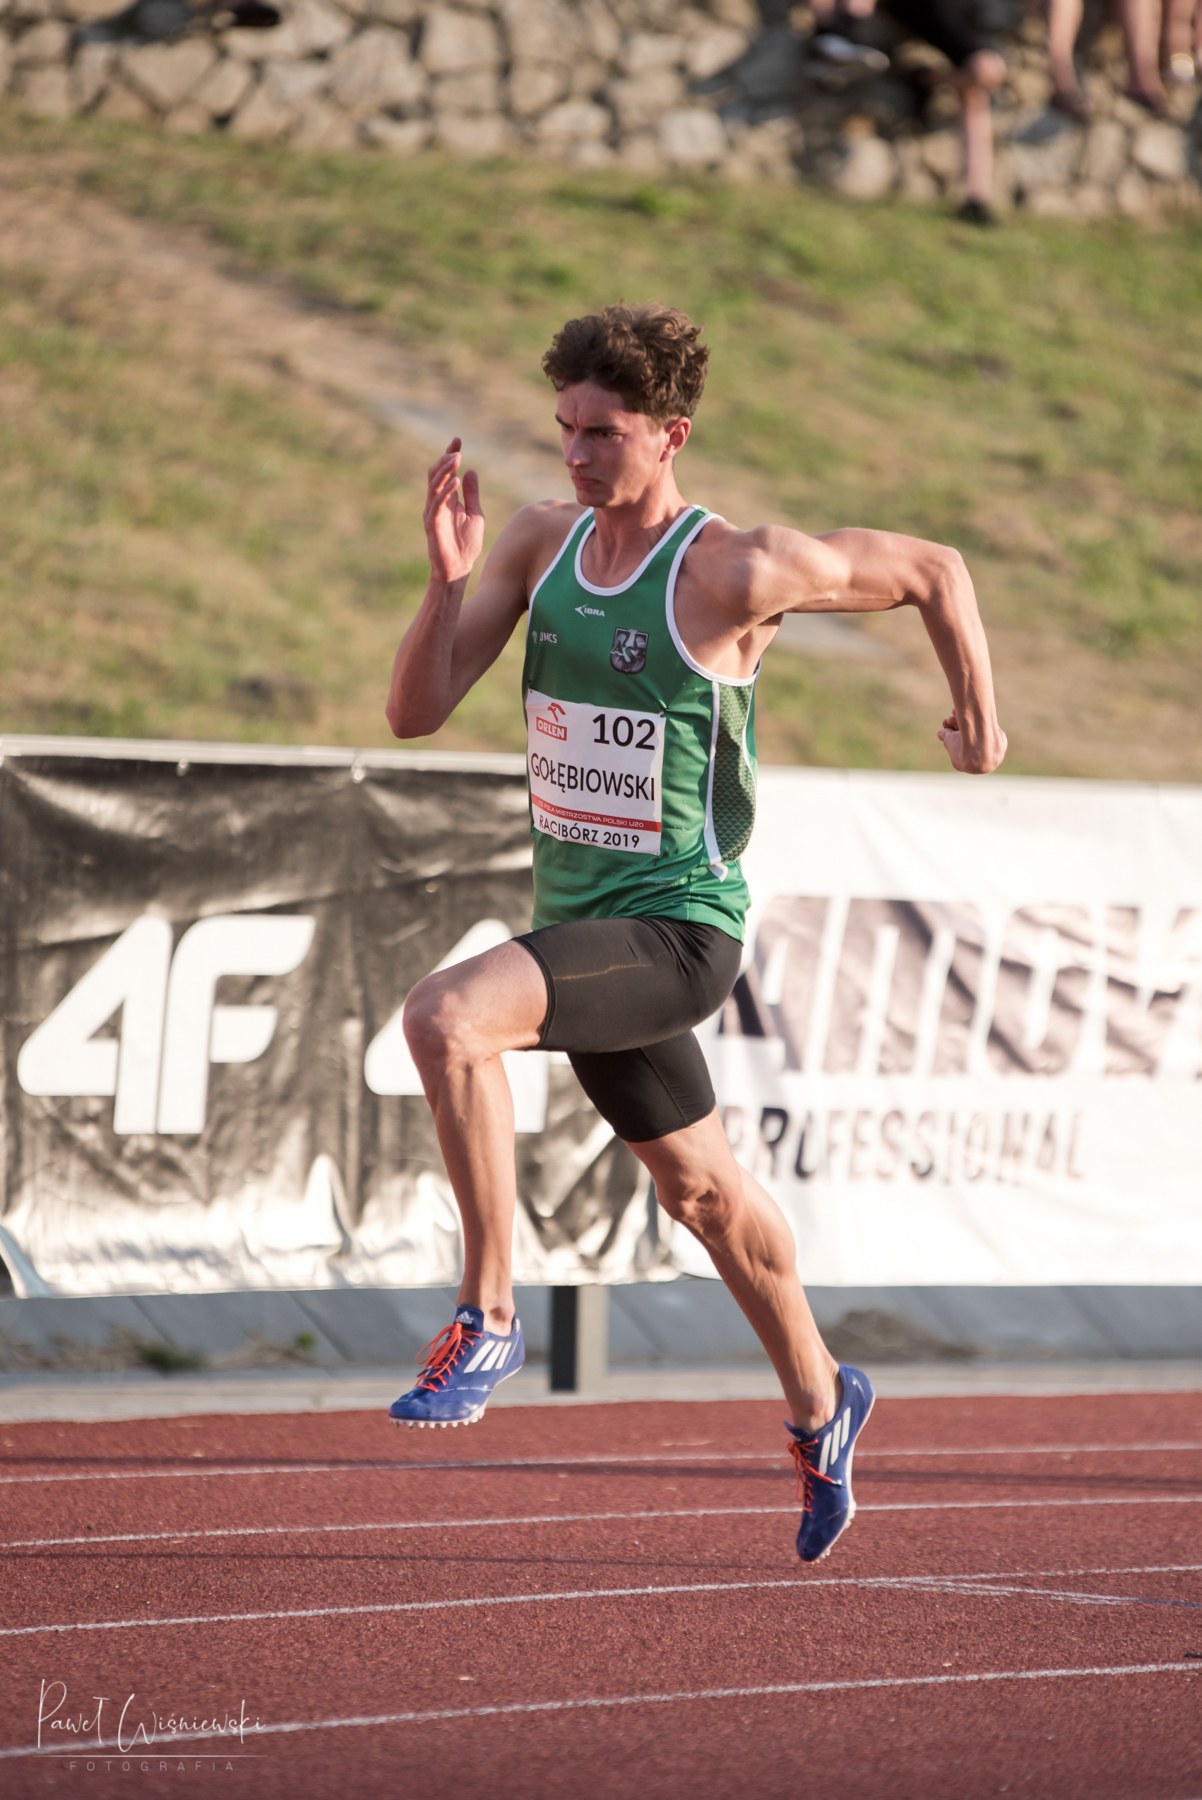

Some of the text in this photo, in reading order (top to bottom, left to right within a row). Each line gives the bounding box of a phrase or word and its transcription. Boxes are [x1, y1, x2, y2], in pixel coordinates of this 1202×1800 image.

[537, 721, 565, 739] ORLEN
[592, 713, 656, 751] 102
[530, 752, 655, 801] GOŁĘBIOWSKI
[539, 814, 640, 848] RACIBÓRZ 2019
[555, 808, 602, 823] MISTRZOSTWA
[602, 817, 628, 827] POLSKI
[628, 820, 645, 828] U20
[17, 914, 316, 1134] 4F
